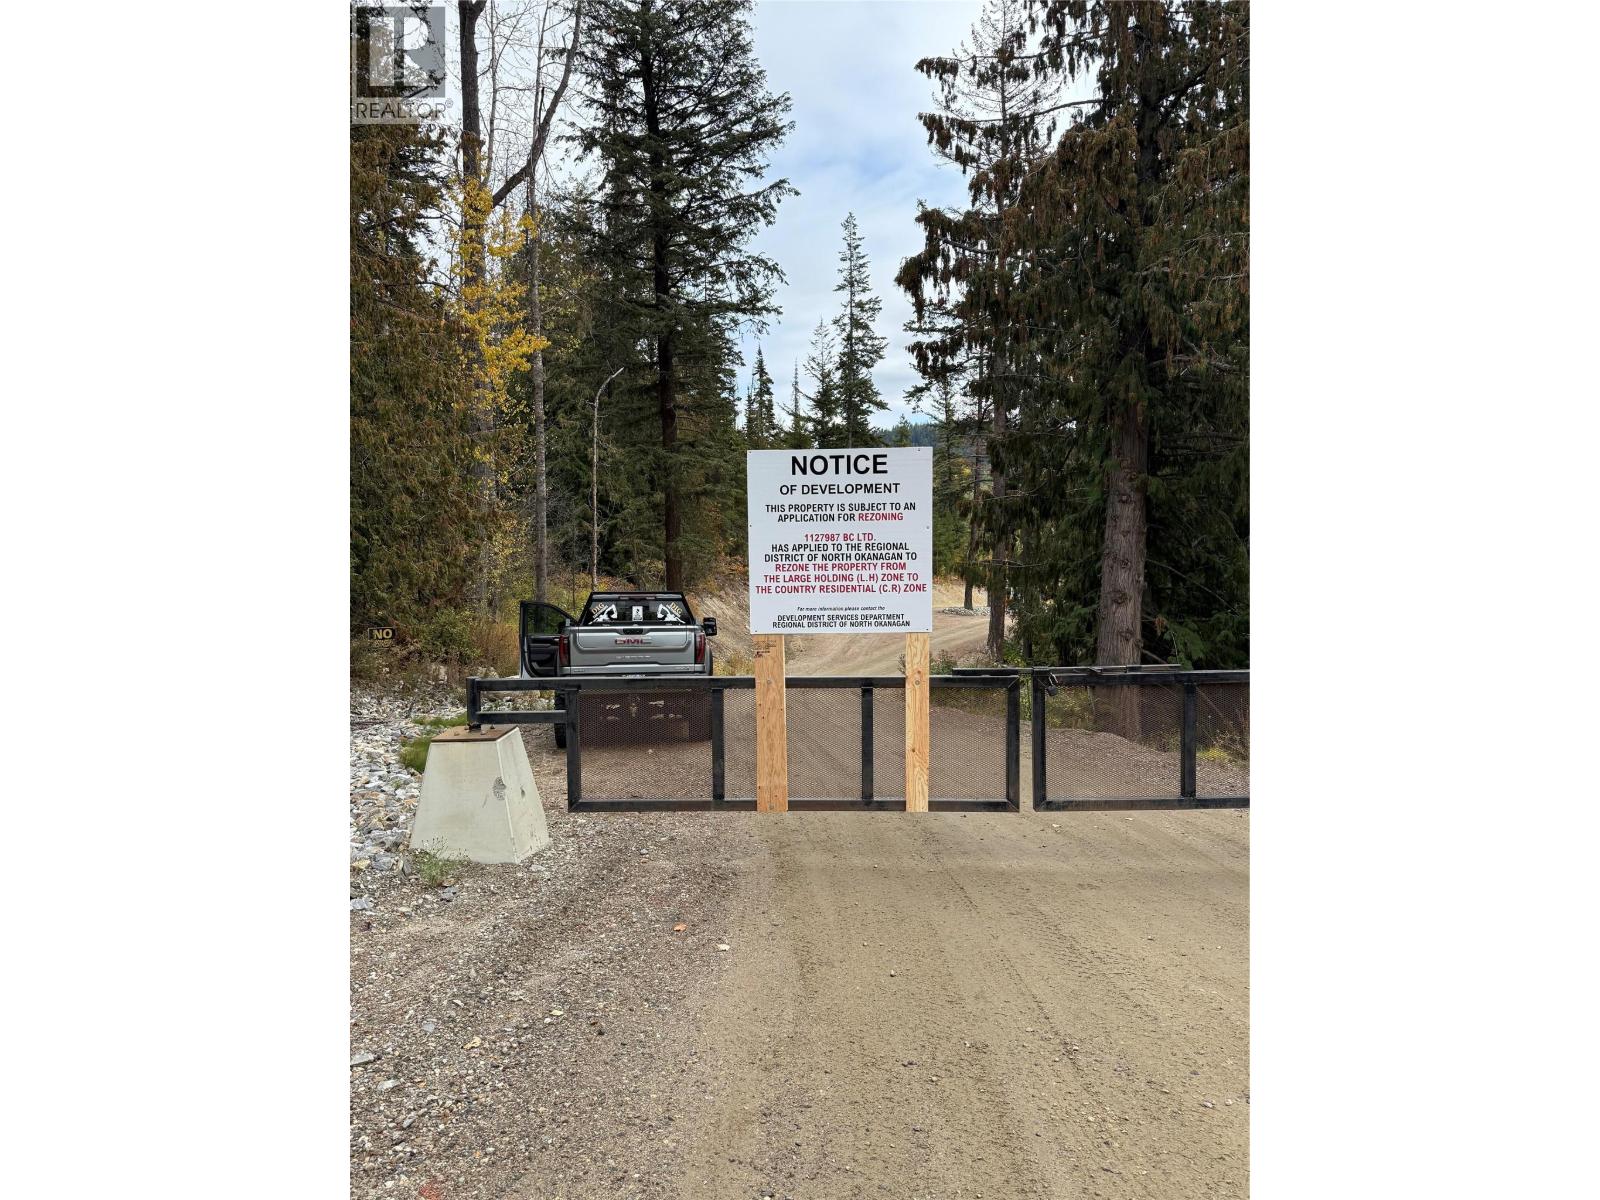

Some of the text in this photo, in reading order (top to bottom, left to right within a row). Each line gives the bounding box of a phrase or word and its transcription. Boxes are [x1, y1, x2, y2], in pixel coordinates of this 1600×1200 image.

[791, 454, 888, 475] NOTICE
[780, 483, 900, 495] OF DEVELOPMENT
[788, 503, 834, 512] PROPERTY
[848, 503, 887, 511] SUBJECT
[778, 513, 903, 522] APPLICATION FOR REZONING
[804, 533, 840, 542] 1127987
[857, 533, 876, 541] LTD.
[792, 543, 829, 552] APPLIED
[865, 542, 909, 551] REGIONAL
[764, 553, 807, 562] DISTRICT
[809, 553, 819, 562] OF
[822, 553, 852, 561] NORTH
[855, 552, 903, 561] OKANAGAN
[775, 563, 810, 572] REZONE
[832, 563, 878, 571] PROPERTY
[881, 562, 906, 571] FROM
[764, 573, 918, 583] THE LARGE HOLDING (L.H) ZONE TO
[756, 584, 927, 594] THE COUNTRY RESIDENTIAL (C.R) ZONE
[669, 601, 683, 614] DIG
[373, 629, 392, 639] NO
